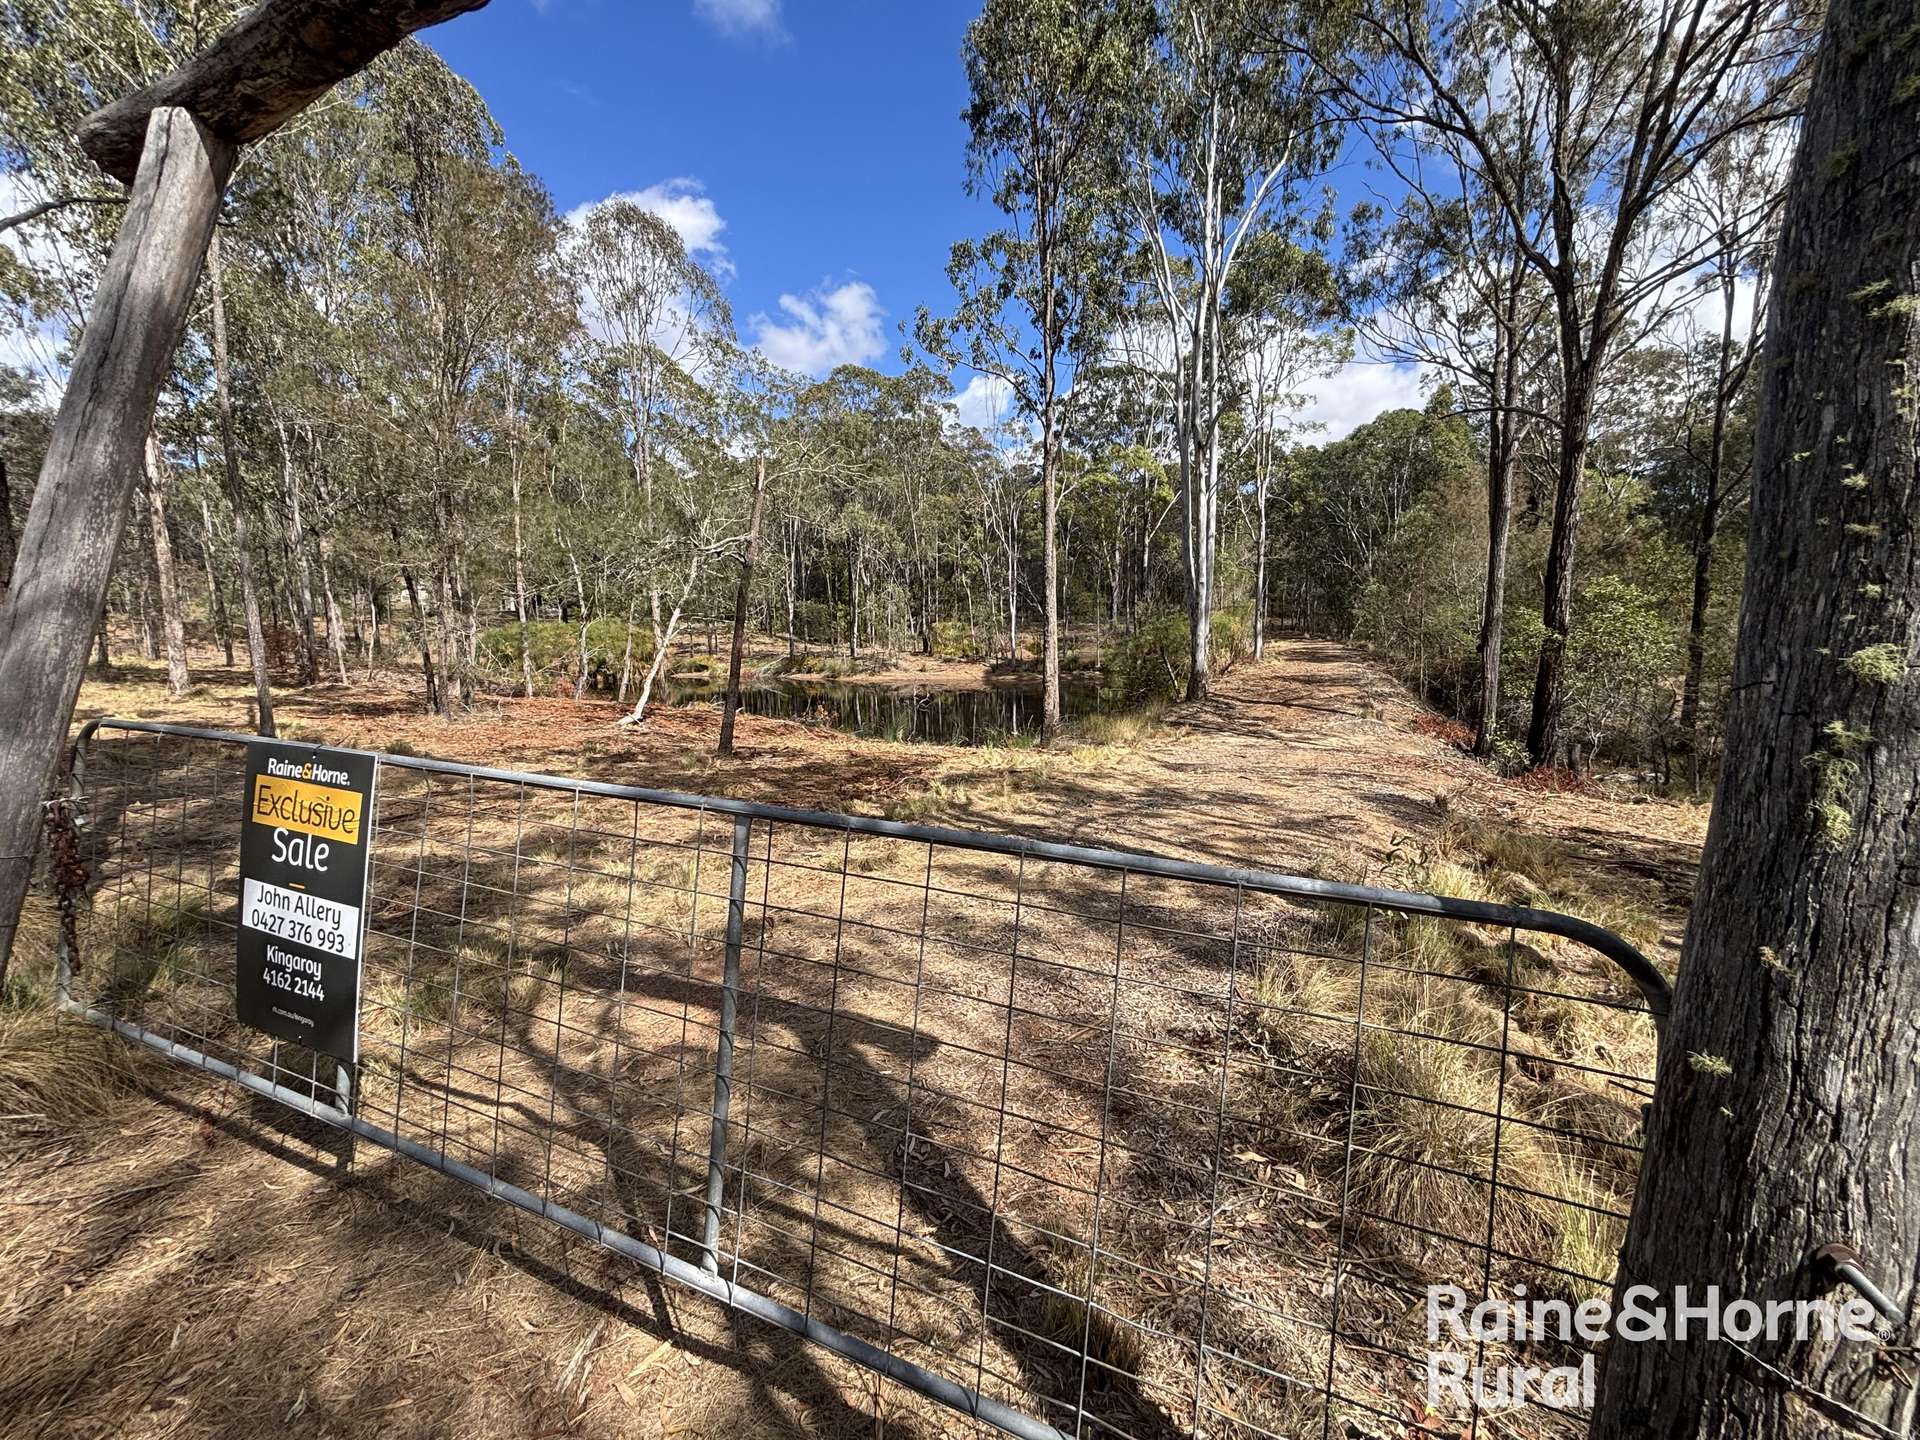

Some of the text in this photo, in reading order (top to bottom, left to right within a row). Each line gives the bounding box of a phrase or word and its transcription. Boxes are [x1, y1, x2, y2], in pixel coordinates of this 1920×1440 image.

[256, 784, 355, 834] Exclusive
[271, 827, 330, 872] Sale
[257, 884, 342, 931] John Allery
[251, 908, 345, 954] 0427 376 993
[263, 967, 325, 1002] 4162 2144
[266, 944, 322, 981] Kingaroy
